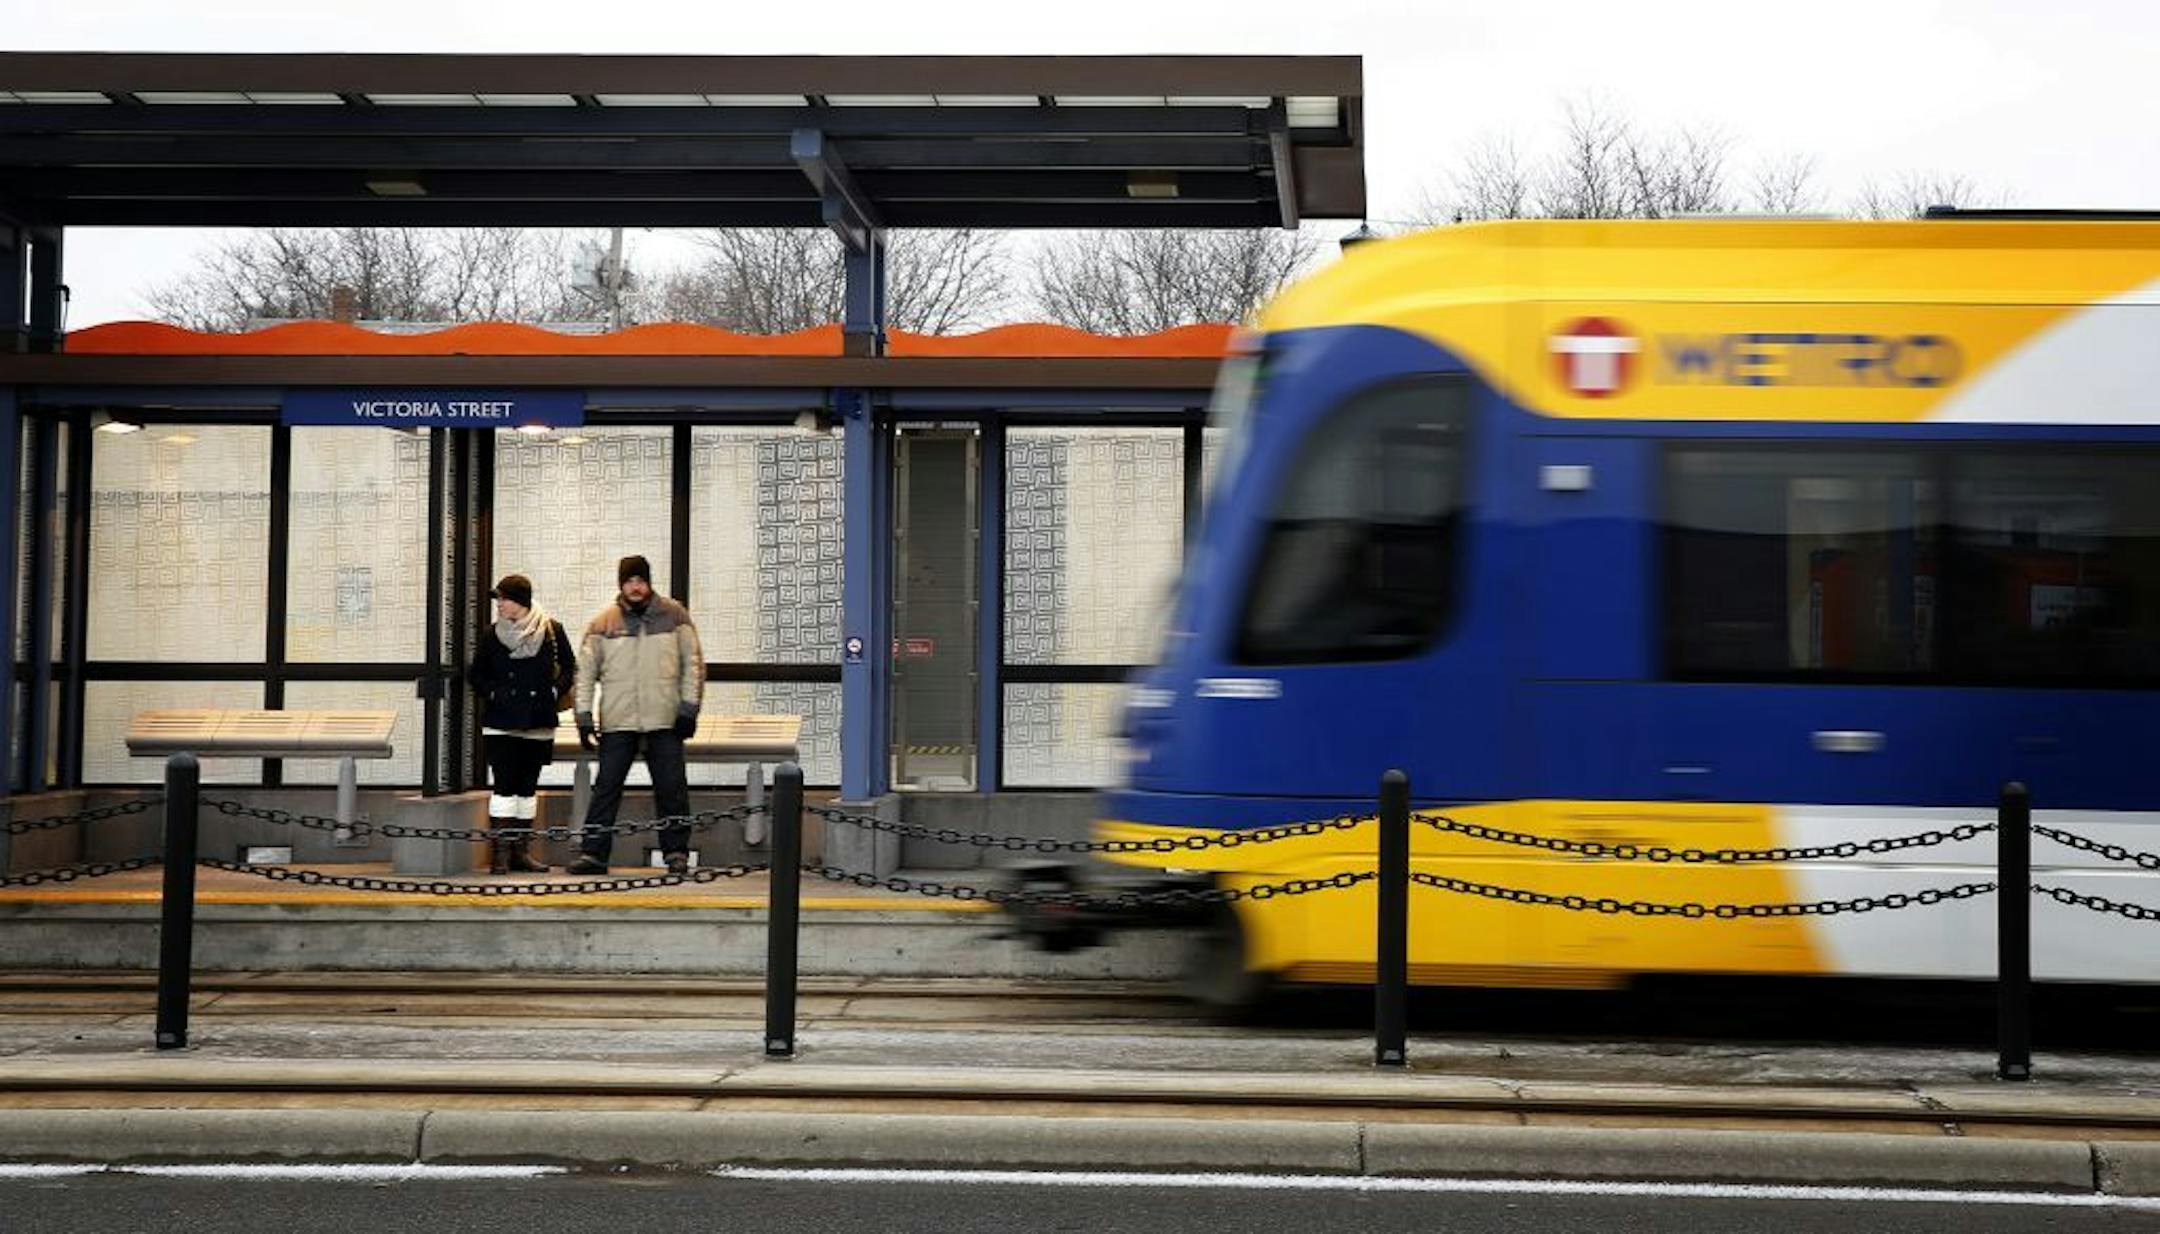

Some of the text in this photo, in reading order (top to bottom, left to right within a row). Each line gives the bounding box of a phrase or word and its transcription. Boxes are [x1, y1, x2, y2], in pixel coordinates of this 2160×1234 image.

[1656, 332, 1962, 388] METRO
[353, 401, 514, 417] VICTORIA STREET
